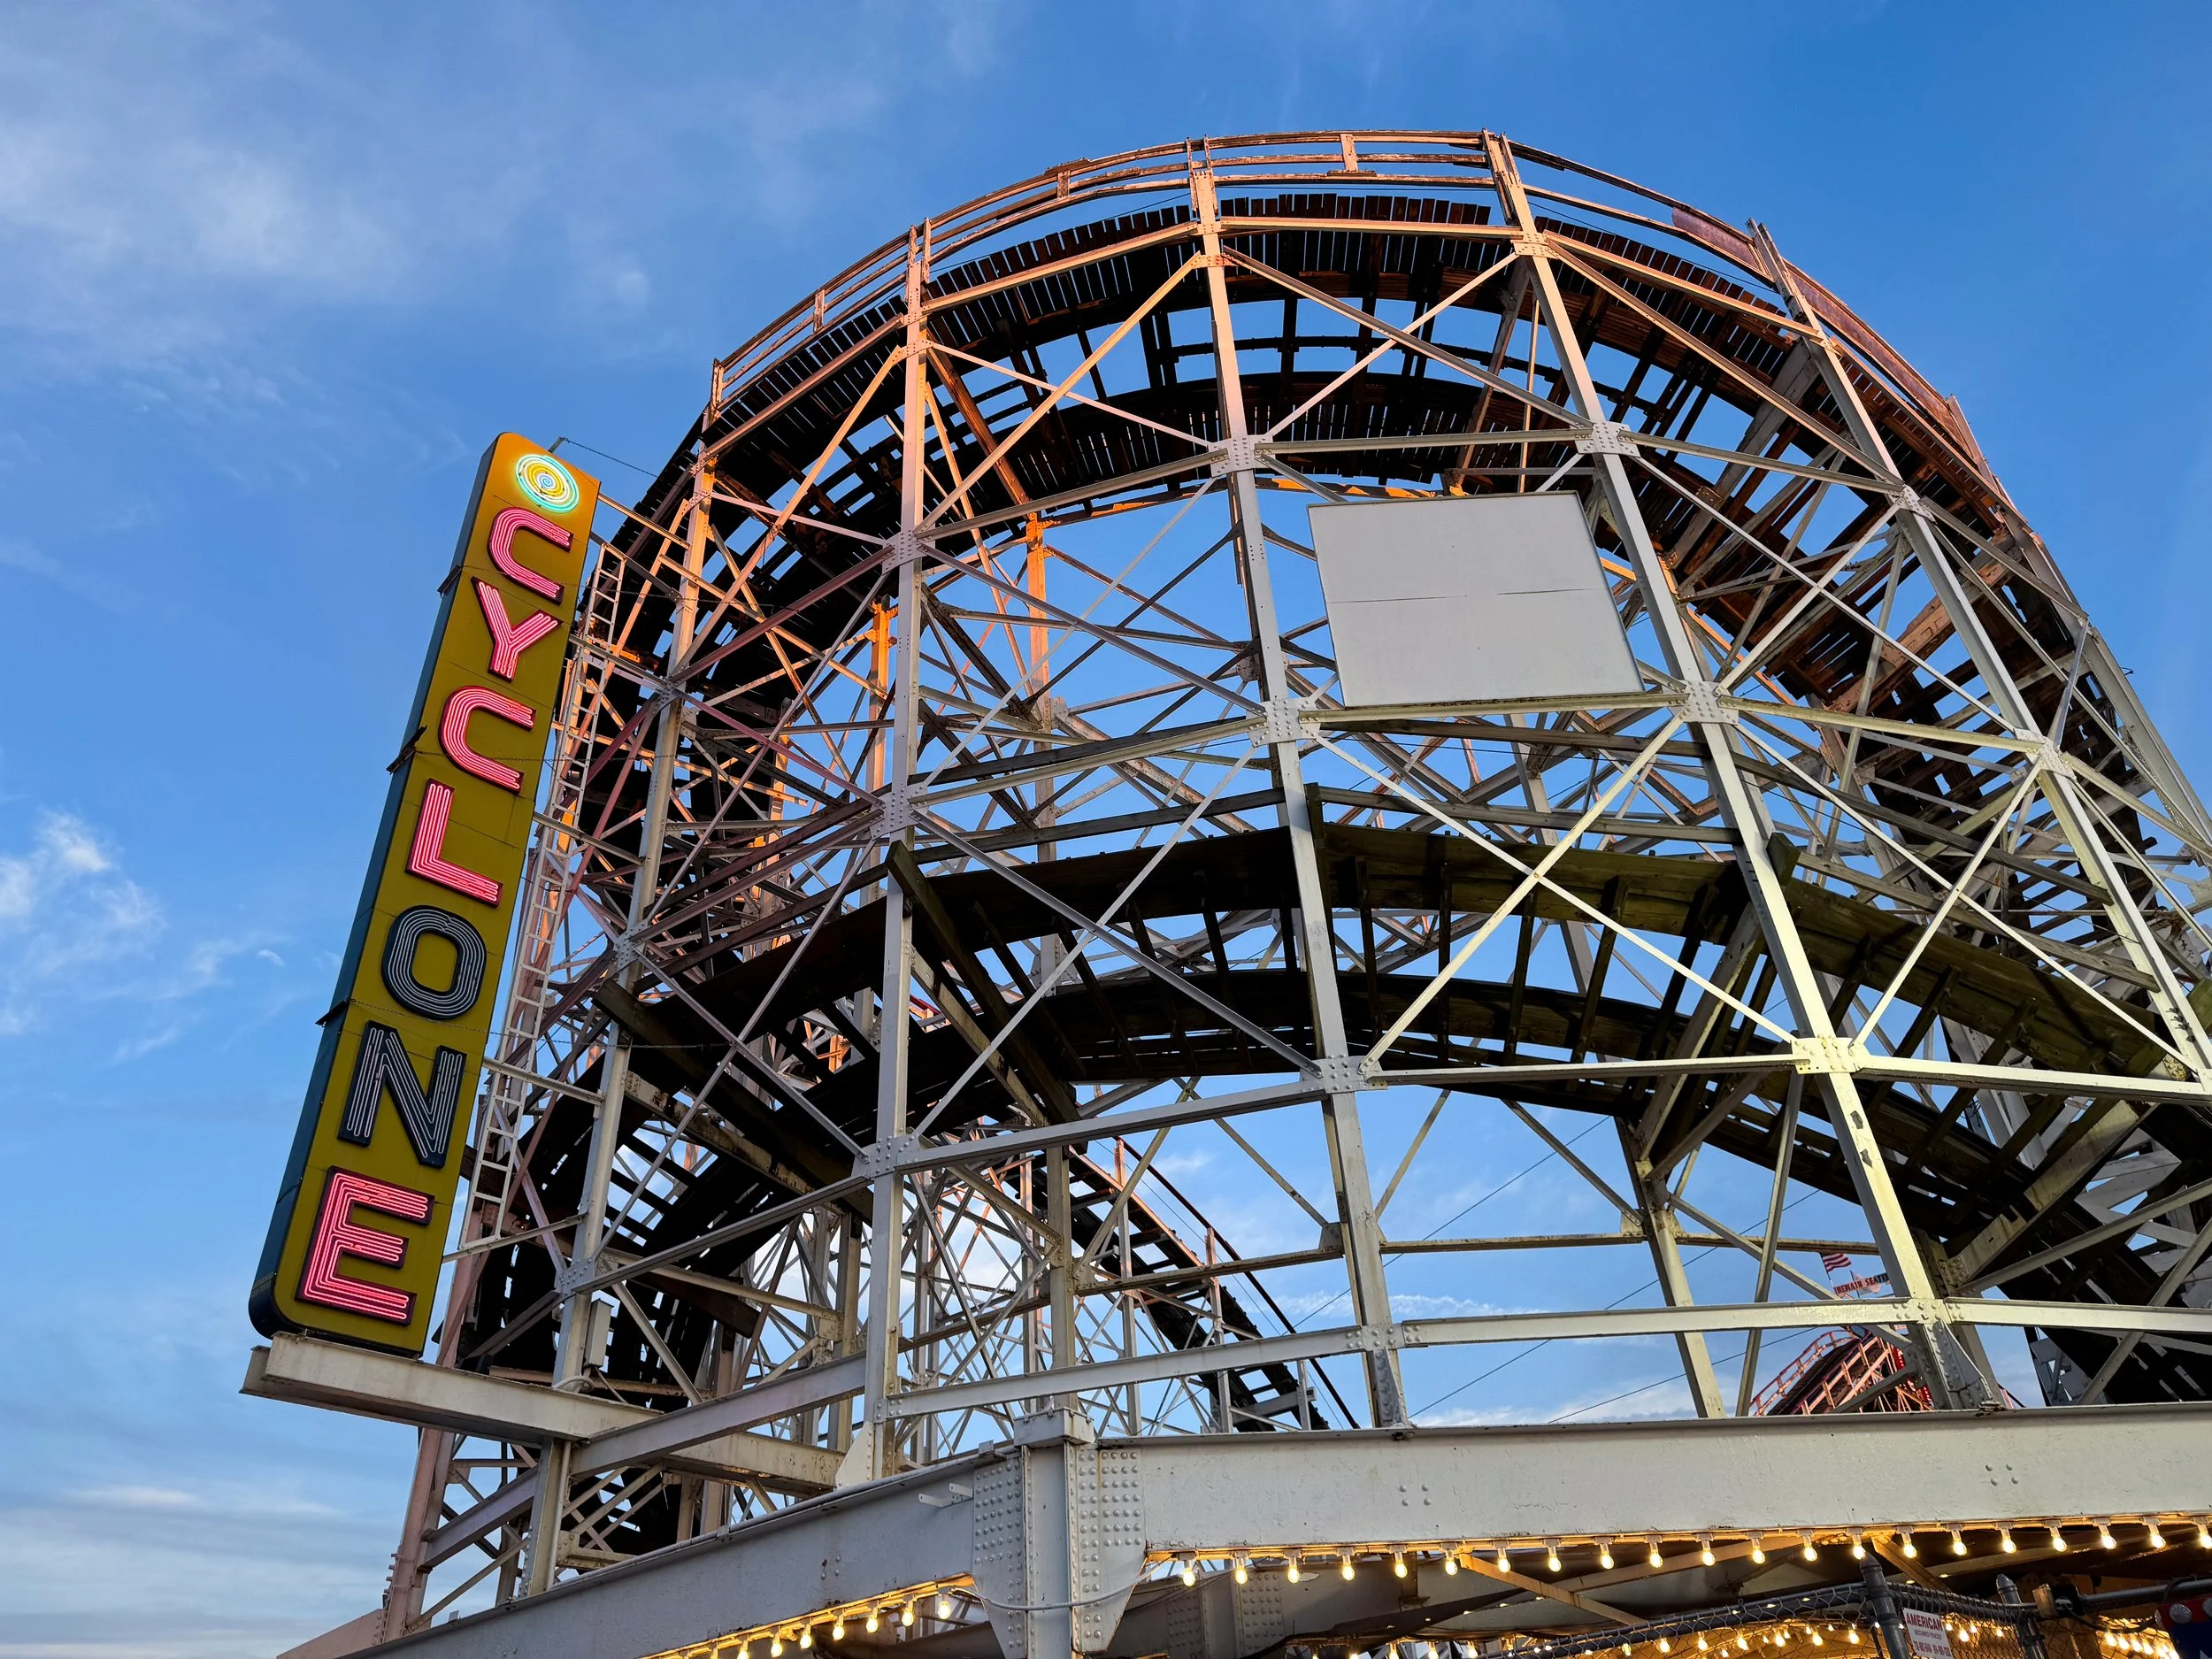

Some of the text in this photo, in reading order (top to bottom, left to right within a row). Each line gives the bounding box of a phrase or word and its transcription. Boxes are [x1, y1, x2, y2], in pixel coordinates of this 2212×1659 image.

[296, 506, 573, 1325] CYCLONE
[1836, 1280, 1863, 1294] REMAIN
[1906, 1612, 1943, 1632] AMERICAN
